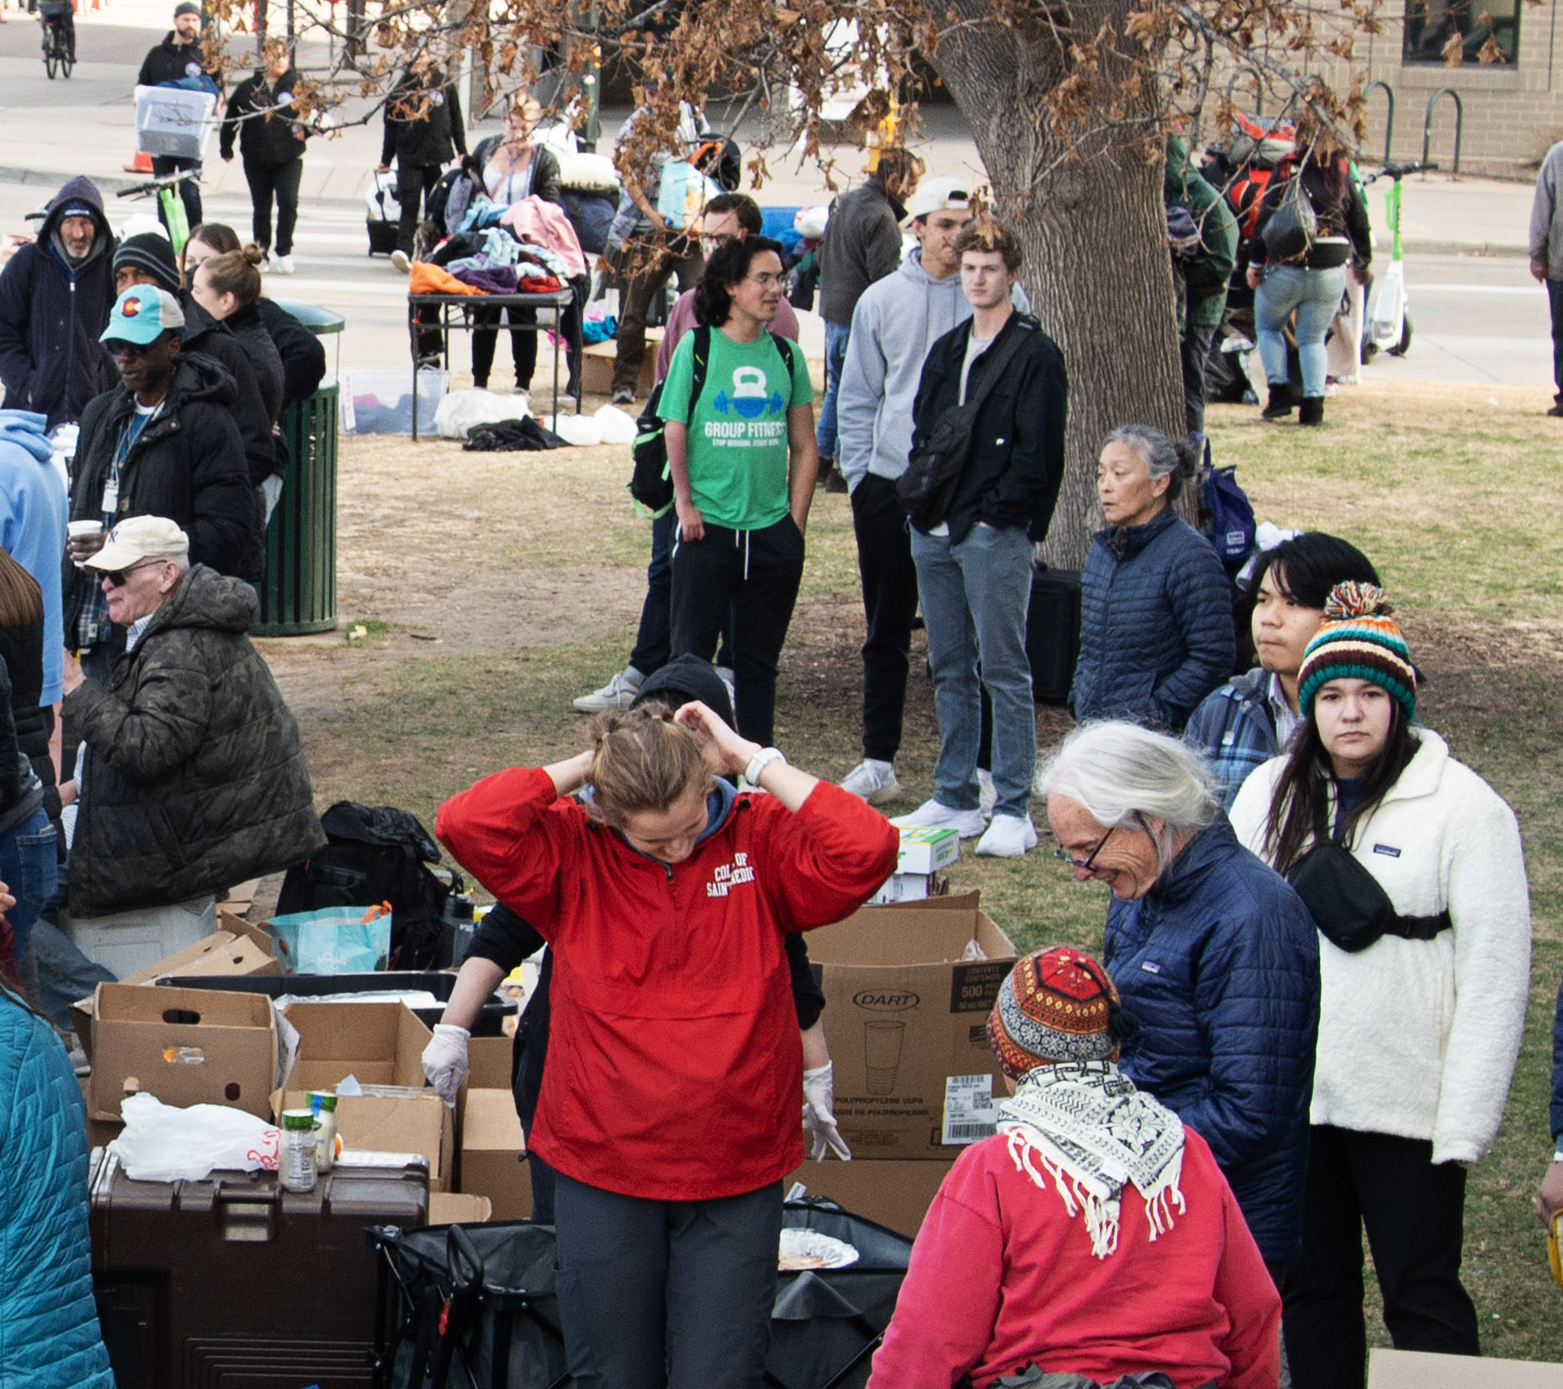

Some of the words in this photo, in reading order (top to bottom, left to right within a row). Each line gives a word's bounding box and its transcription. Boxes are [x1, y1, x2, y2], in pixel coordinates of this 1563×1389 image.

[704, 421, 746, 439] GROUP
[735, 852, 749, 867] OF
[961, 985, 983, 998] 500
[860, 995, 914, 1006] DART
